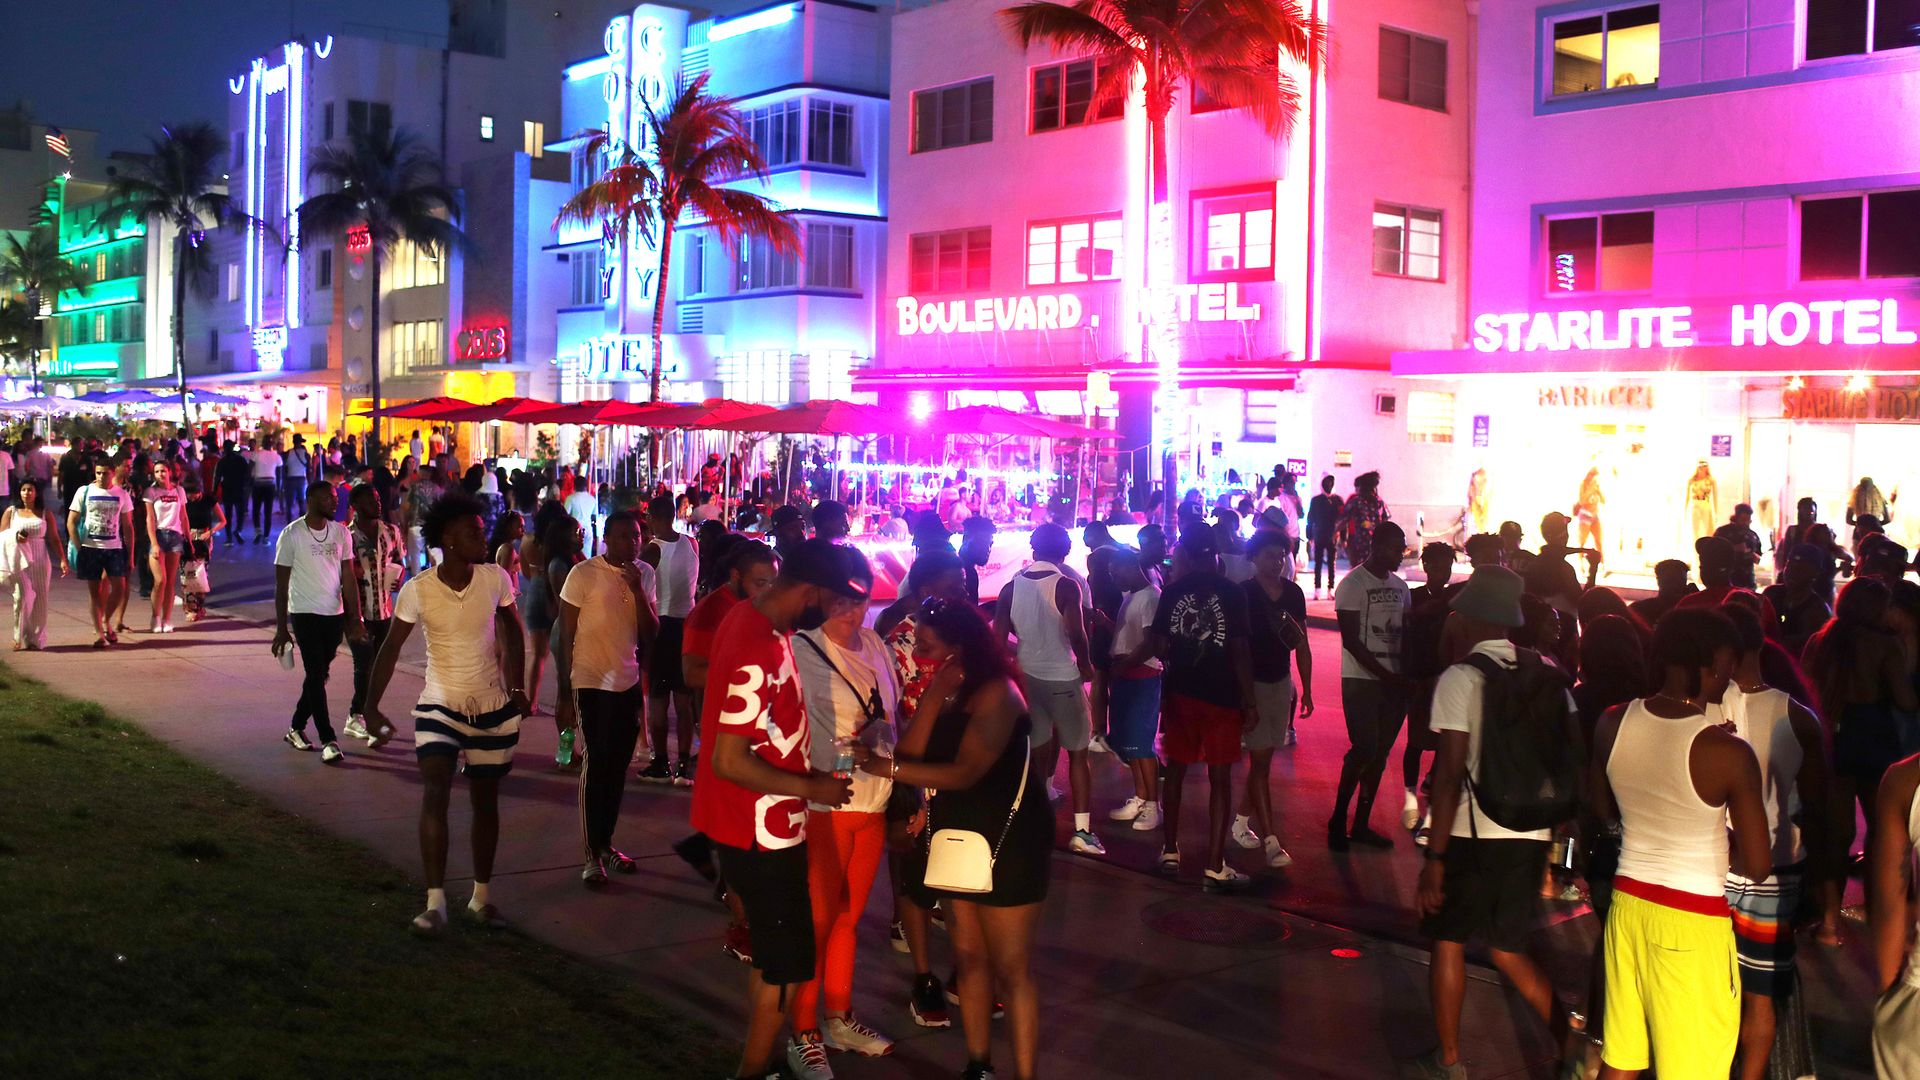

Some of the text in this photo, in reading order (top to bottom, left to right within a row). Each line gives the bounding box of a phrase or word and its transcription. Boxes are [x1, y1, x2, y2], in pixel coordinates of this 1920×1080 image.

[896, 294, 1083, 336] BOULEVARD
[1473, 298, 1918, 353] STARLITE HOTEL
[1288, 461, 1306, 474] FDC
